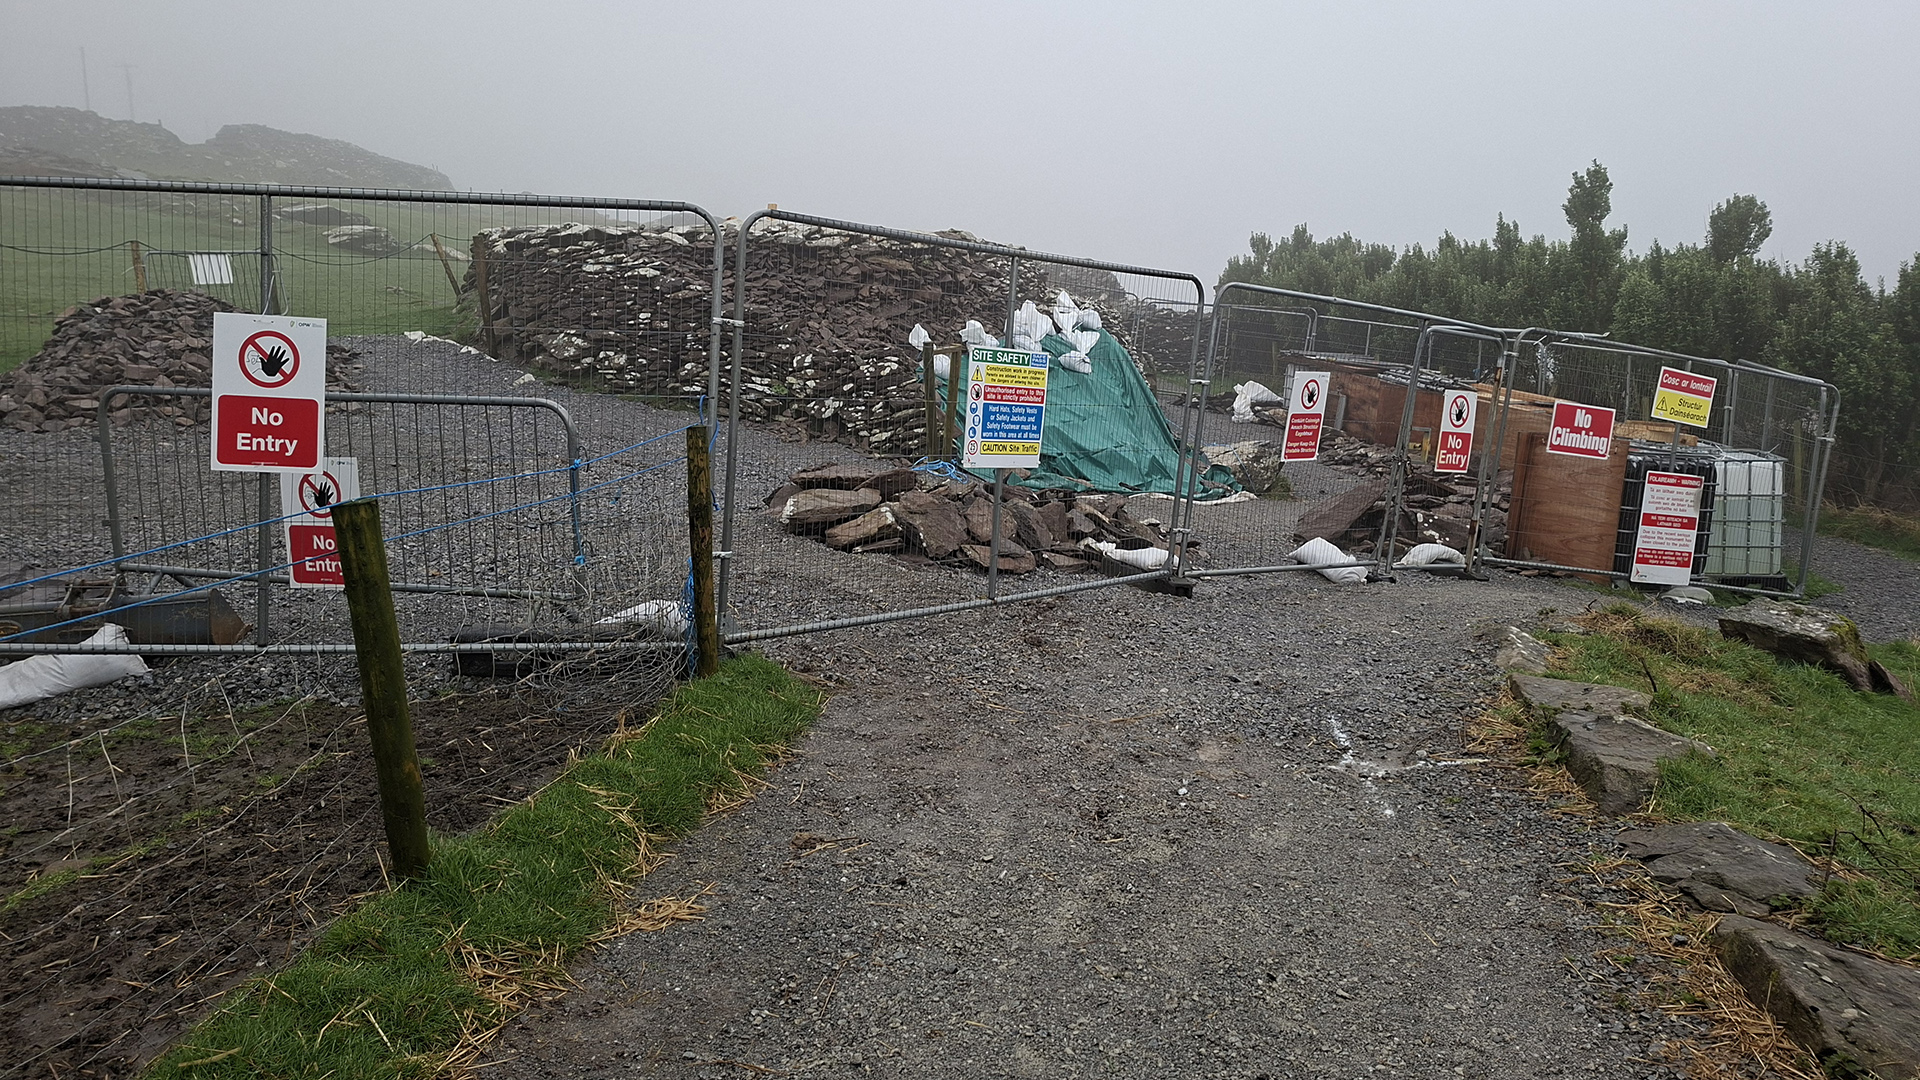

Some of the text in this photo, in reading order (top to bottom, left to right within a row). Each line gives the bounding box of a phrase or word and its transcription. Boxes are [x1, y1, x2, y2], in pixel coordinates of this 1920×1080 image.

[973, 349, 1030, 364] SITE SAFETY
[1662, 373, 1680, 386] Cosc
[985, 386, 1016, 394] Unauthorised
[252, 407, 284, 426] No
[1012, 406, 1025, 414] Safety
[996, 414, 1010, 422] Safety
[1574, 408, 1592, 428] No
[986, 422, 1000, 430] Safety
[236, 432, 298, 457] Entry
[1447, 434, 1462, 449] No
[1552, 426, 1608, 454] Climbing
[982, 444, 1008, 452] CAUTION
[1008, 444, 1020, 452] Site
[1438, 450, 1467, 468] Entry
[312, 535, 336, 550] No
